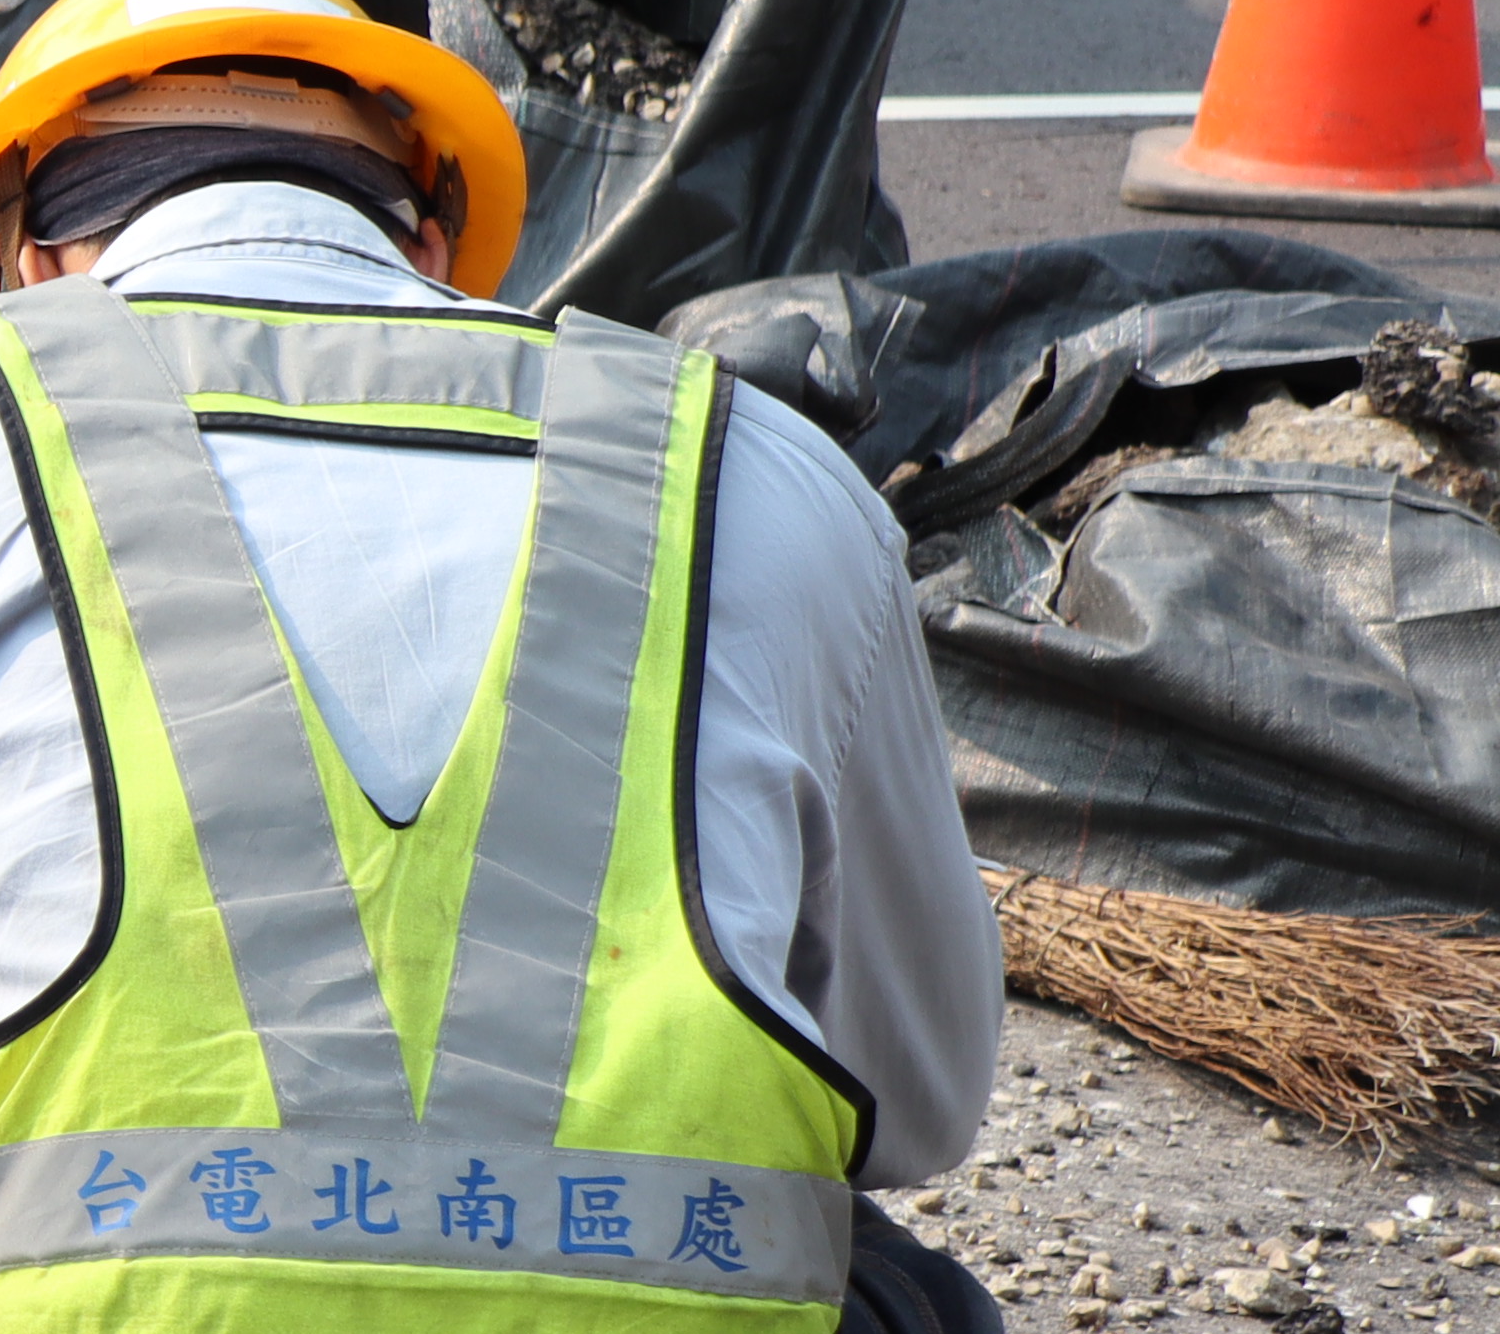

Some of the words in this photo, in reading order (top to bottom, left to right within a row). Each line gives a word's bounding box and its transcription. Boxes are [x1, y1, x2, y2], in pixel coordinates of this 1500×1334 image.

[76, 1146, 750, 1273] 台電北南區處
